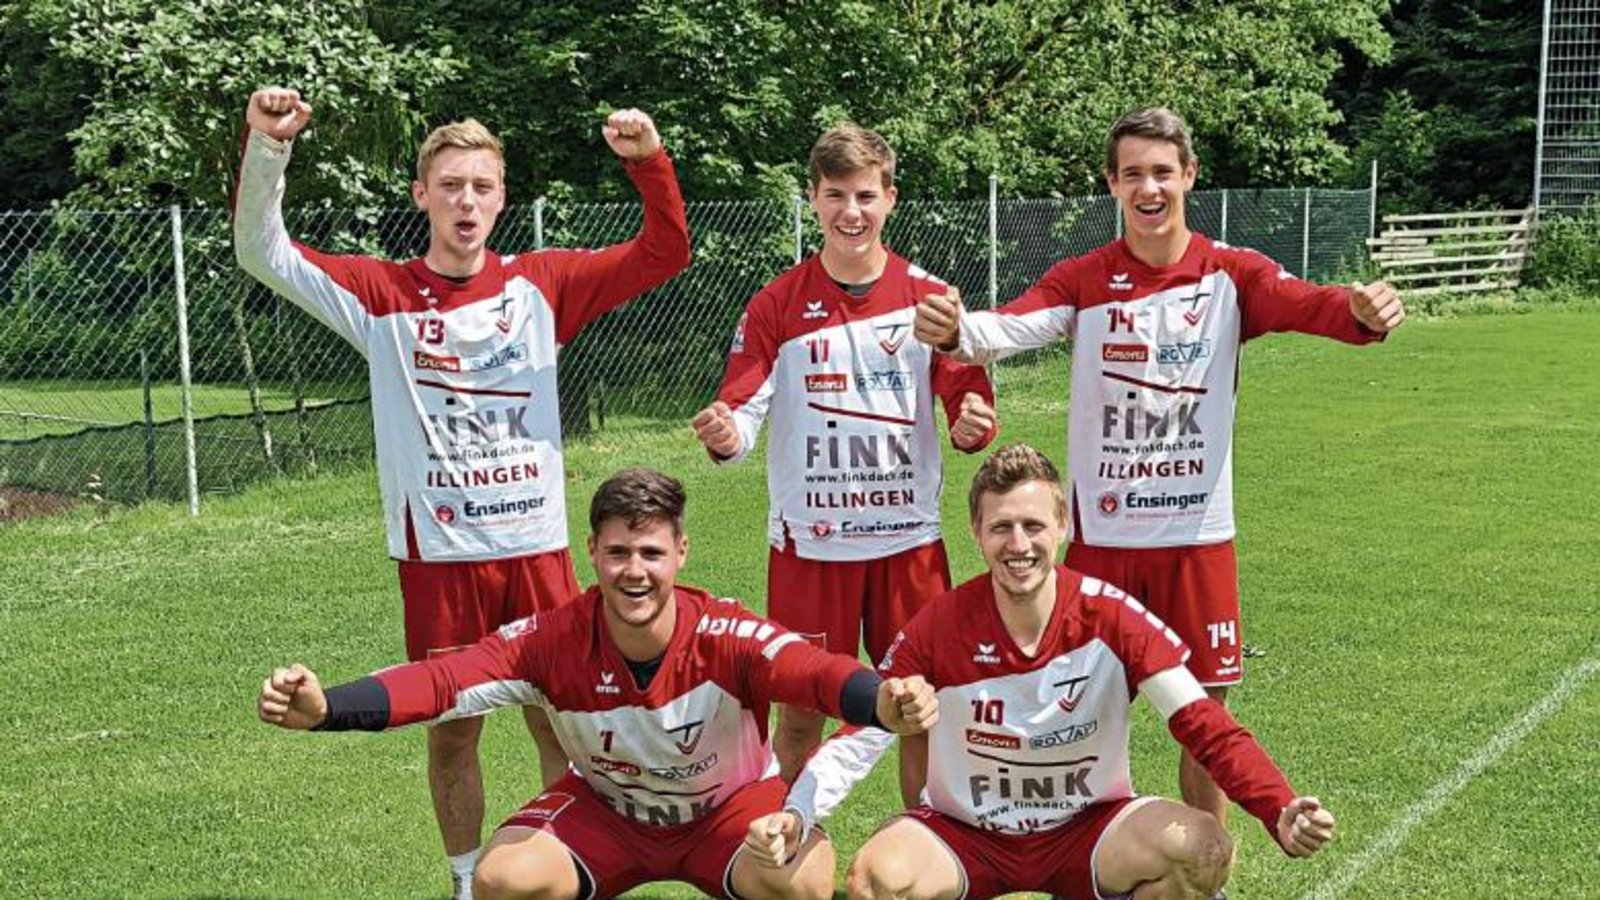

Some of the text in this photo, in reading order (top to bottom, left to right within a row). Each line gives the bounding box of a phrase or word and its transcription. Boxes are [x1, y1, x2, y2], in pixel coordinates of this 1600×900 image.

[416, 318, 444, 344] 13
[1107, 308, 1134, 333] 14
[427, 462, 539, 487] ILLINGEN
[1099, 459, 1203, 479] ILLINGEN
[464, 497, 545, 516] Ensinger
[806, 489, 915, 508] ILLINGEN
[1125, 493, 1208, 509] Ensinger
[1207, 620, 1235, 648] 14
[971, 699, 1004, 725] 10
